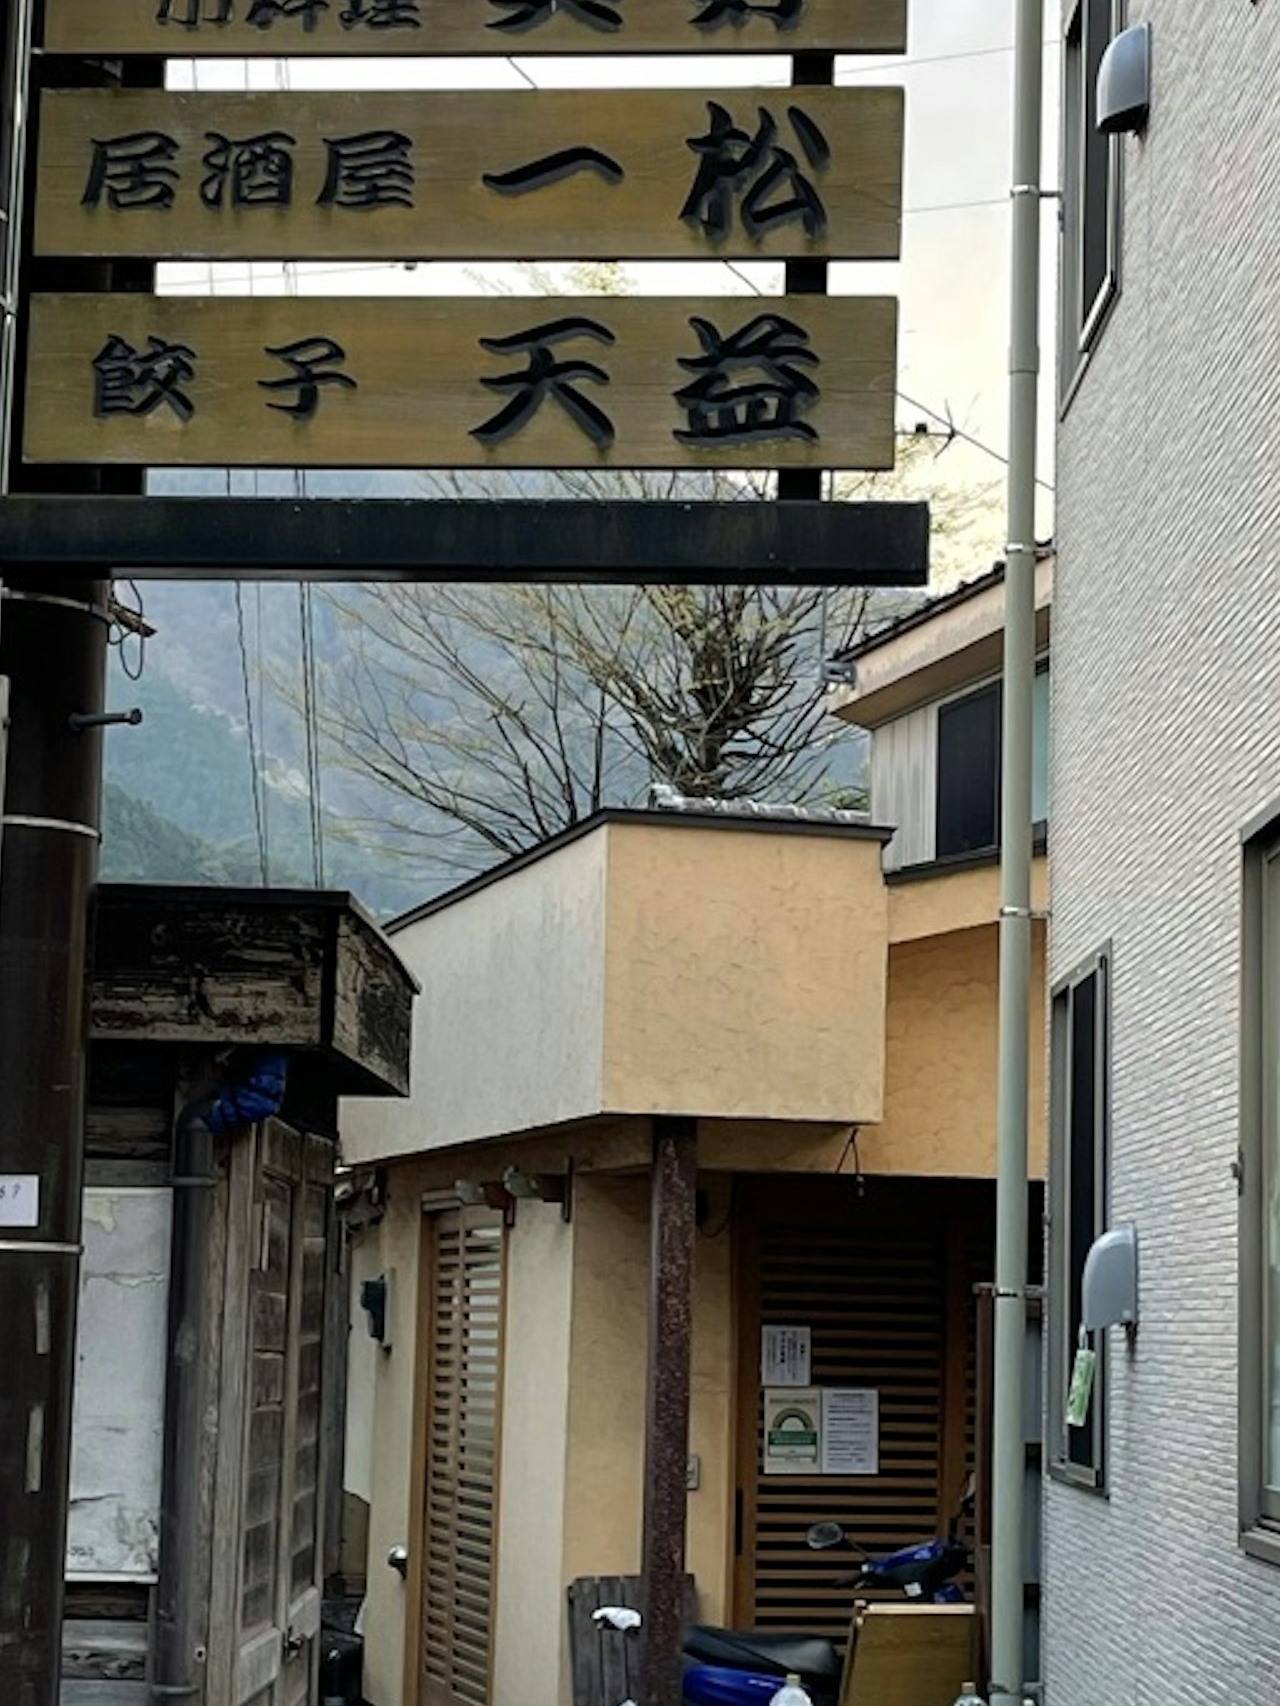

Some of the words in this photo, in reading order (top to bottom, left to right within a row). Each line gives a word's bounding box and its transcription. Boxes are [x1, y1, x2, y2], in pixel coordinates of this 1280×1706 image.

[81, 130, 415, 213] 居酒屋
[482, 102, 830, 241] 一松
[93, 334, 357, 421] 餃子
[469, 314, 821, 449] 天益
